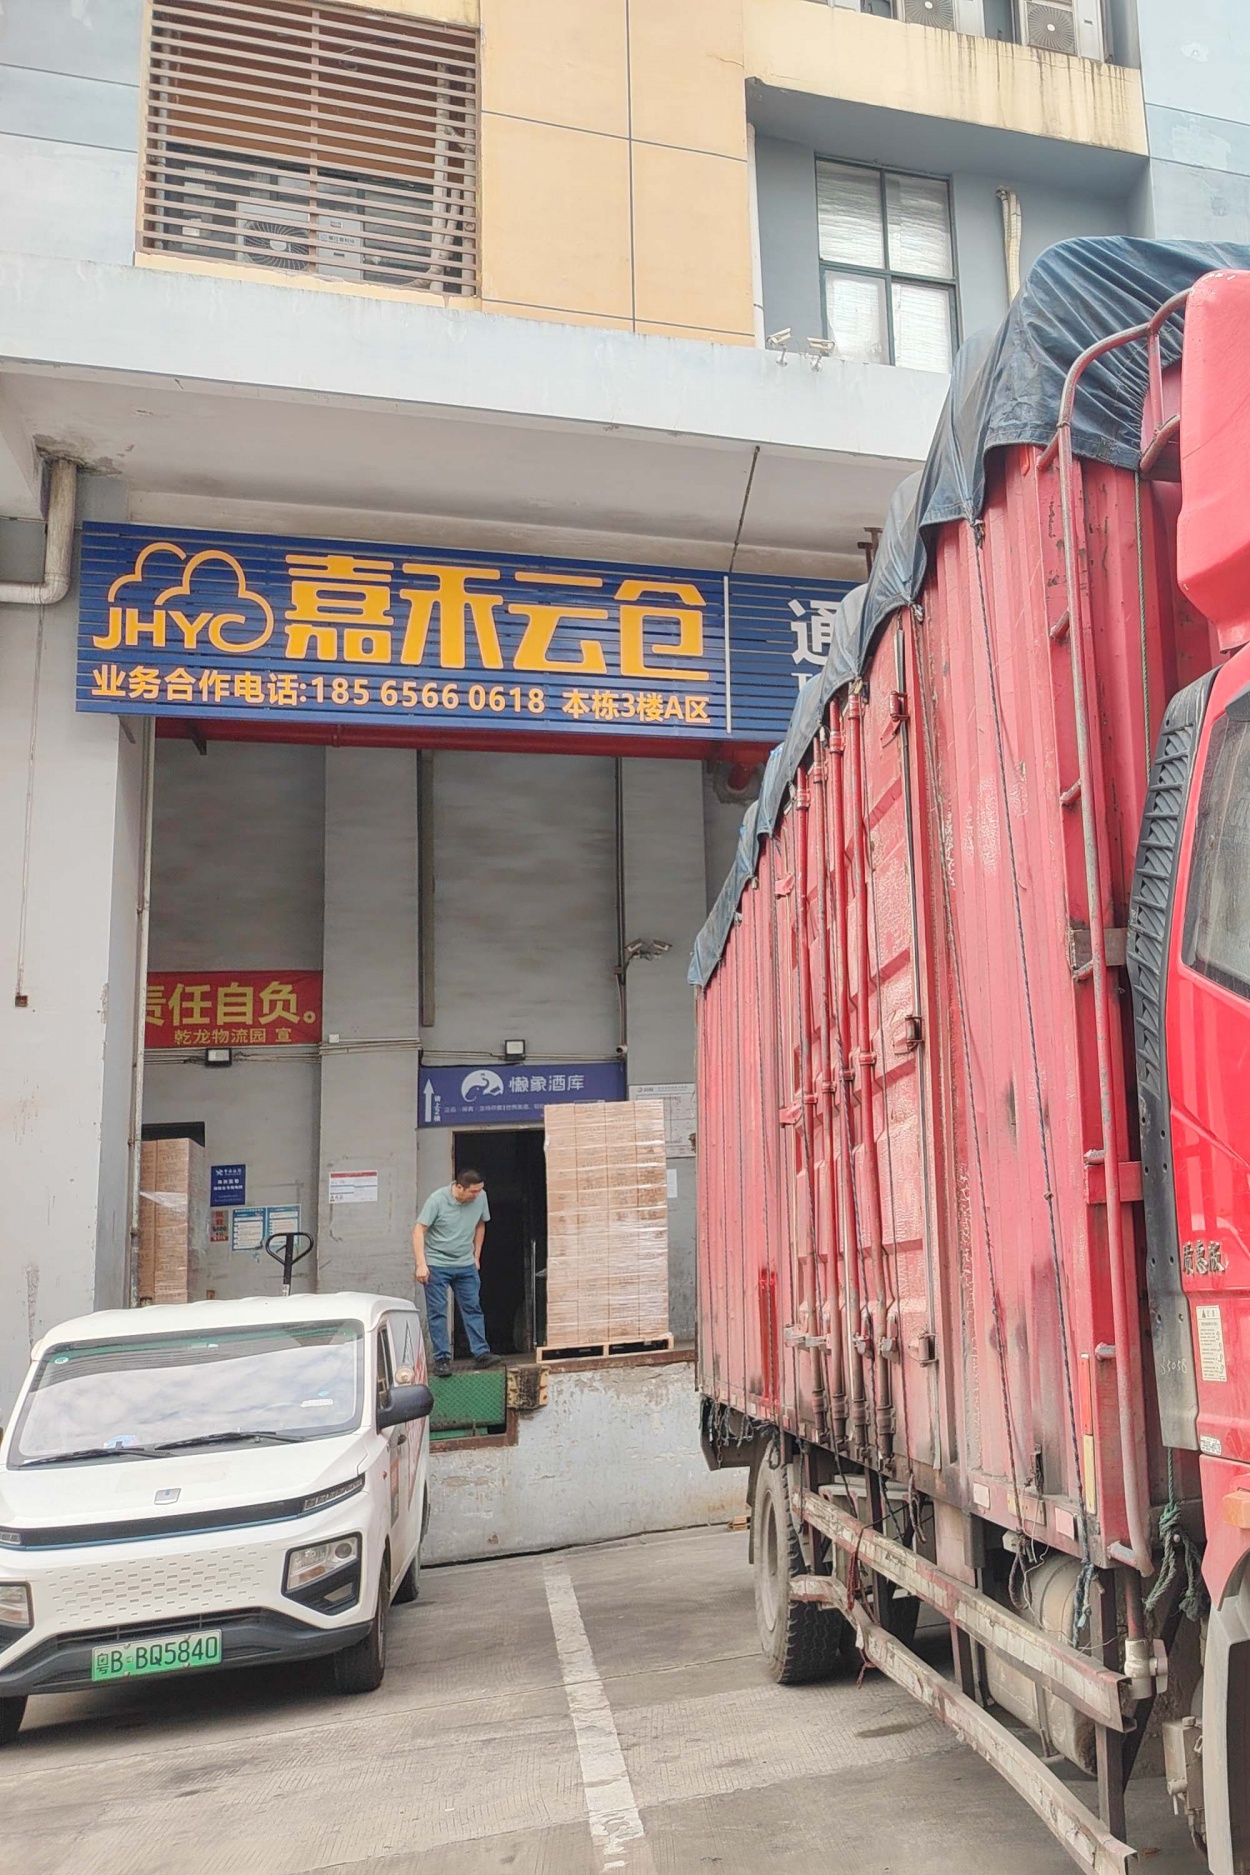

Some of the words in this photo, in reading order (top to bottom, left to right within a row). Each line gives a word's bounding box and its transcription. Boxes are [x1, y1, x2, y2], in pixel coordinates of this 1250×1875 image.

[93, 606, 272, 653] JHYC
[285, 554, 709, 681] 嘉禾云仓
[380, 678, 459, 709] 6566
[468, 684, 546, 714] 0618
[561, 687, 711, 724] 本栋3楼A区
[174, 1027, 266, 1046] 乾龙物流园
[275, 1026, 292, 1043] 宣
[508, 1074, 585, 1093] 懒象酒库
